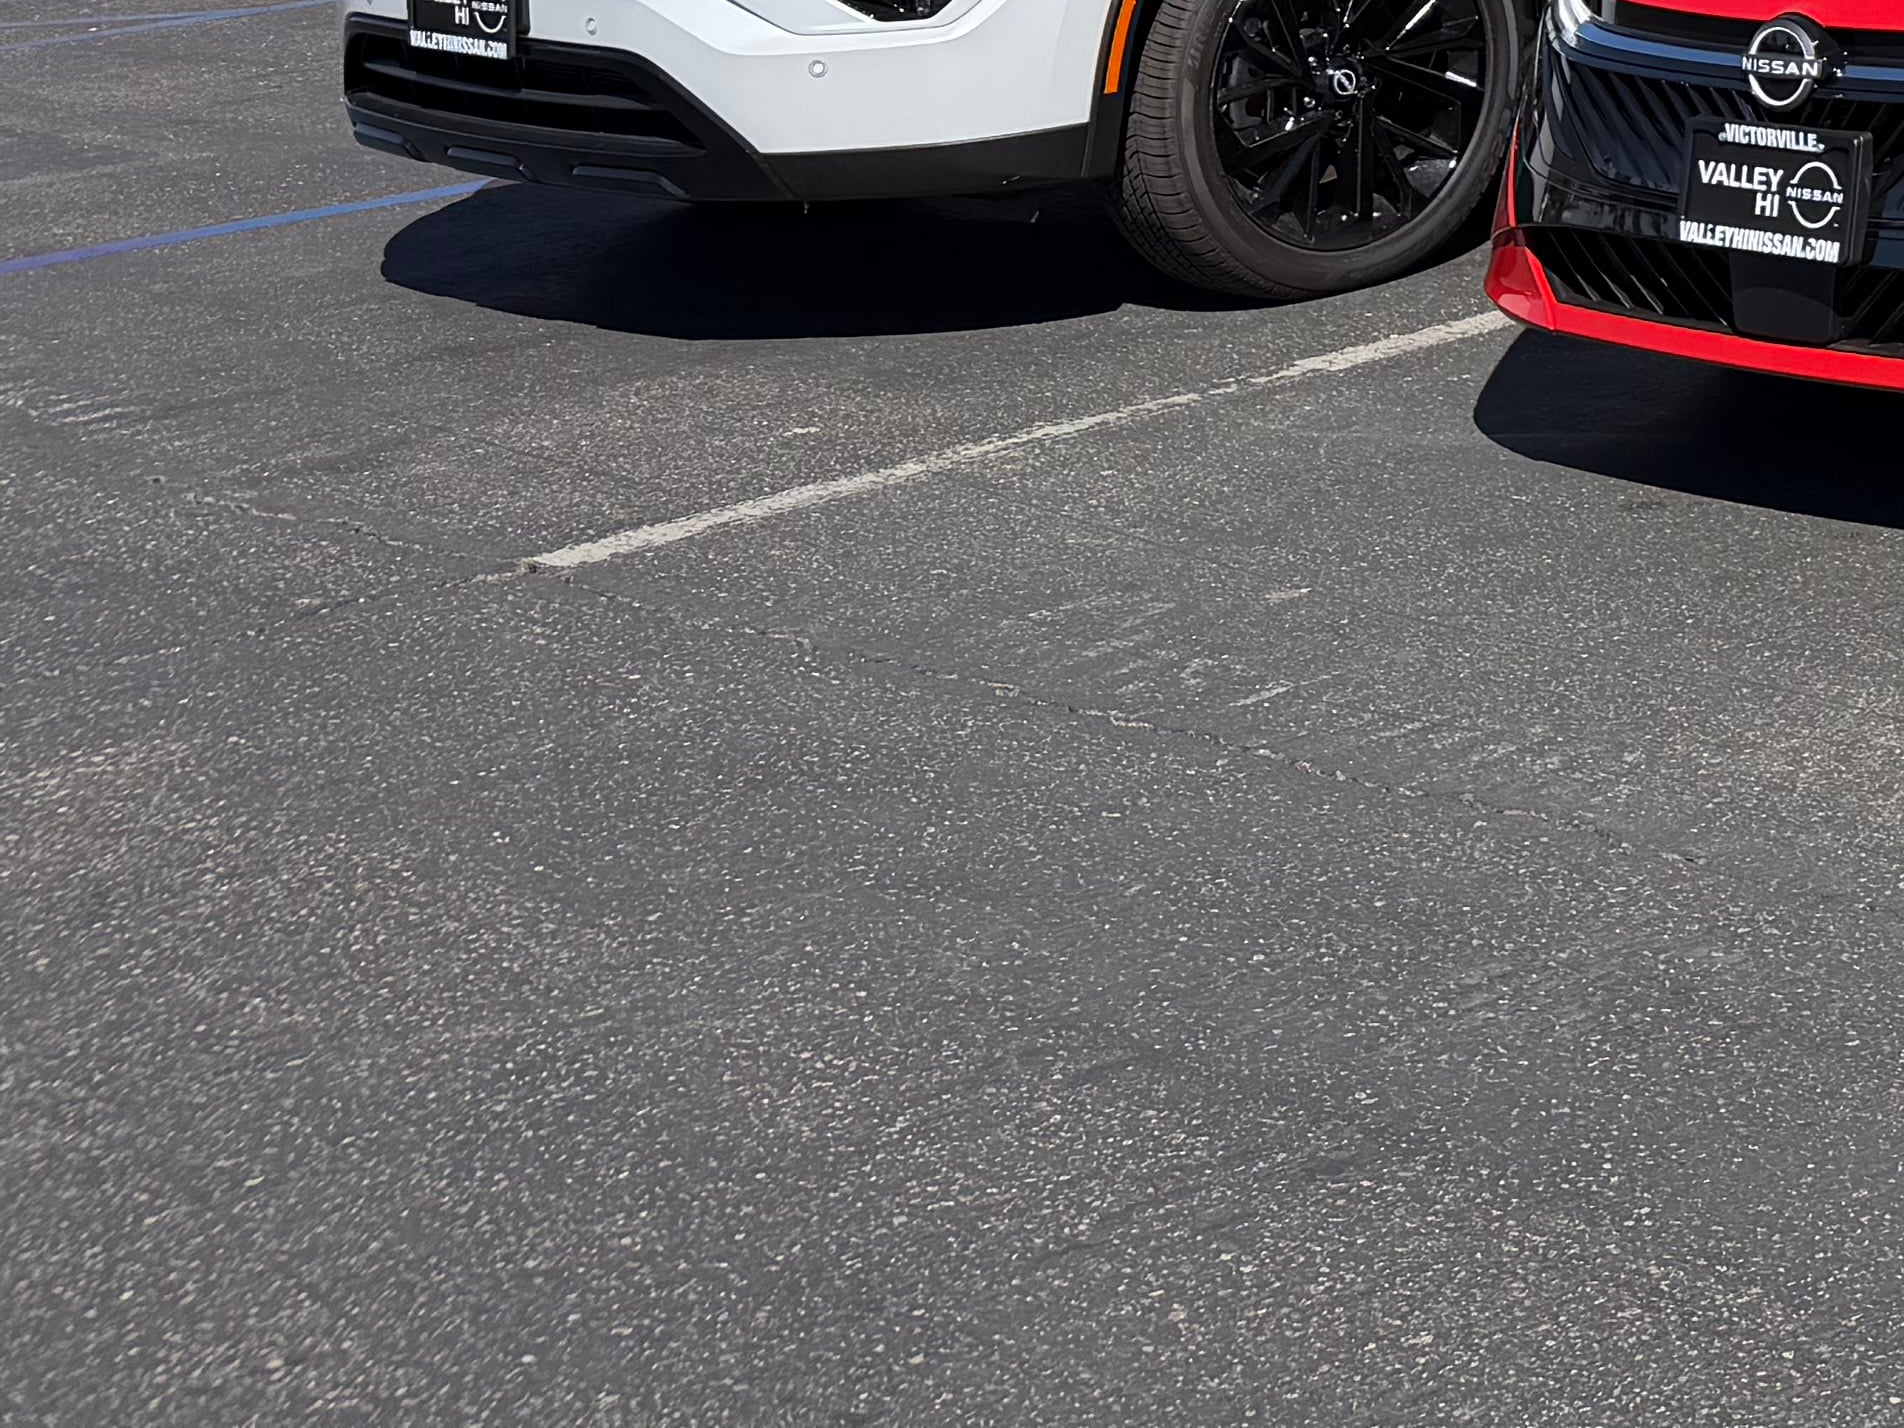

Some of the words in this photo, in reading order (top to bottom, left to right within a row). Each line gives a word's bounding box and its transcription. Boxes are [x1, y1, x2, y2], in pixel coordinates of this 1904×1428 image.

[455, 5, 469, 25] HI
[1742, 56, 1819, 77] NISSAN
[1724, 122, 1819, 152] VICTORVILLE
[1698, 159, 1784, 192] VALLEY
[1755, 192, 1780, 217] HI
[1786, 186, 1844, 204] NISSAN
[1679, 220, 1841, 264] VALLEYHINISSAN.COM
